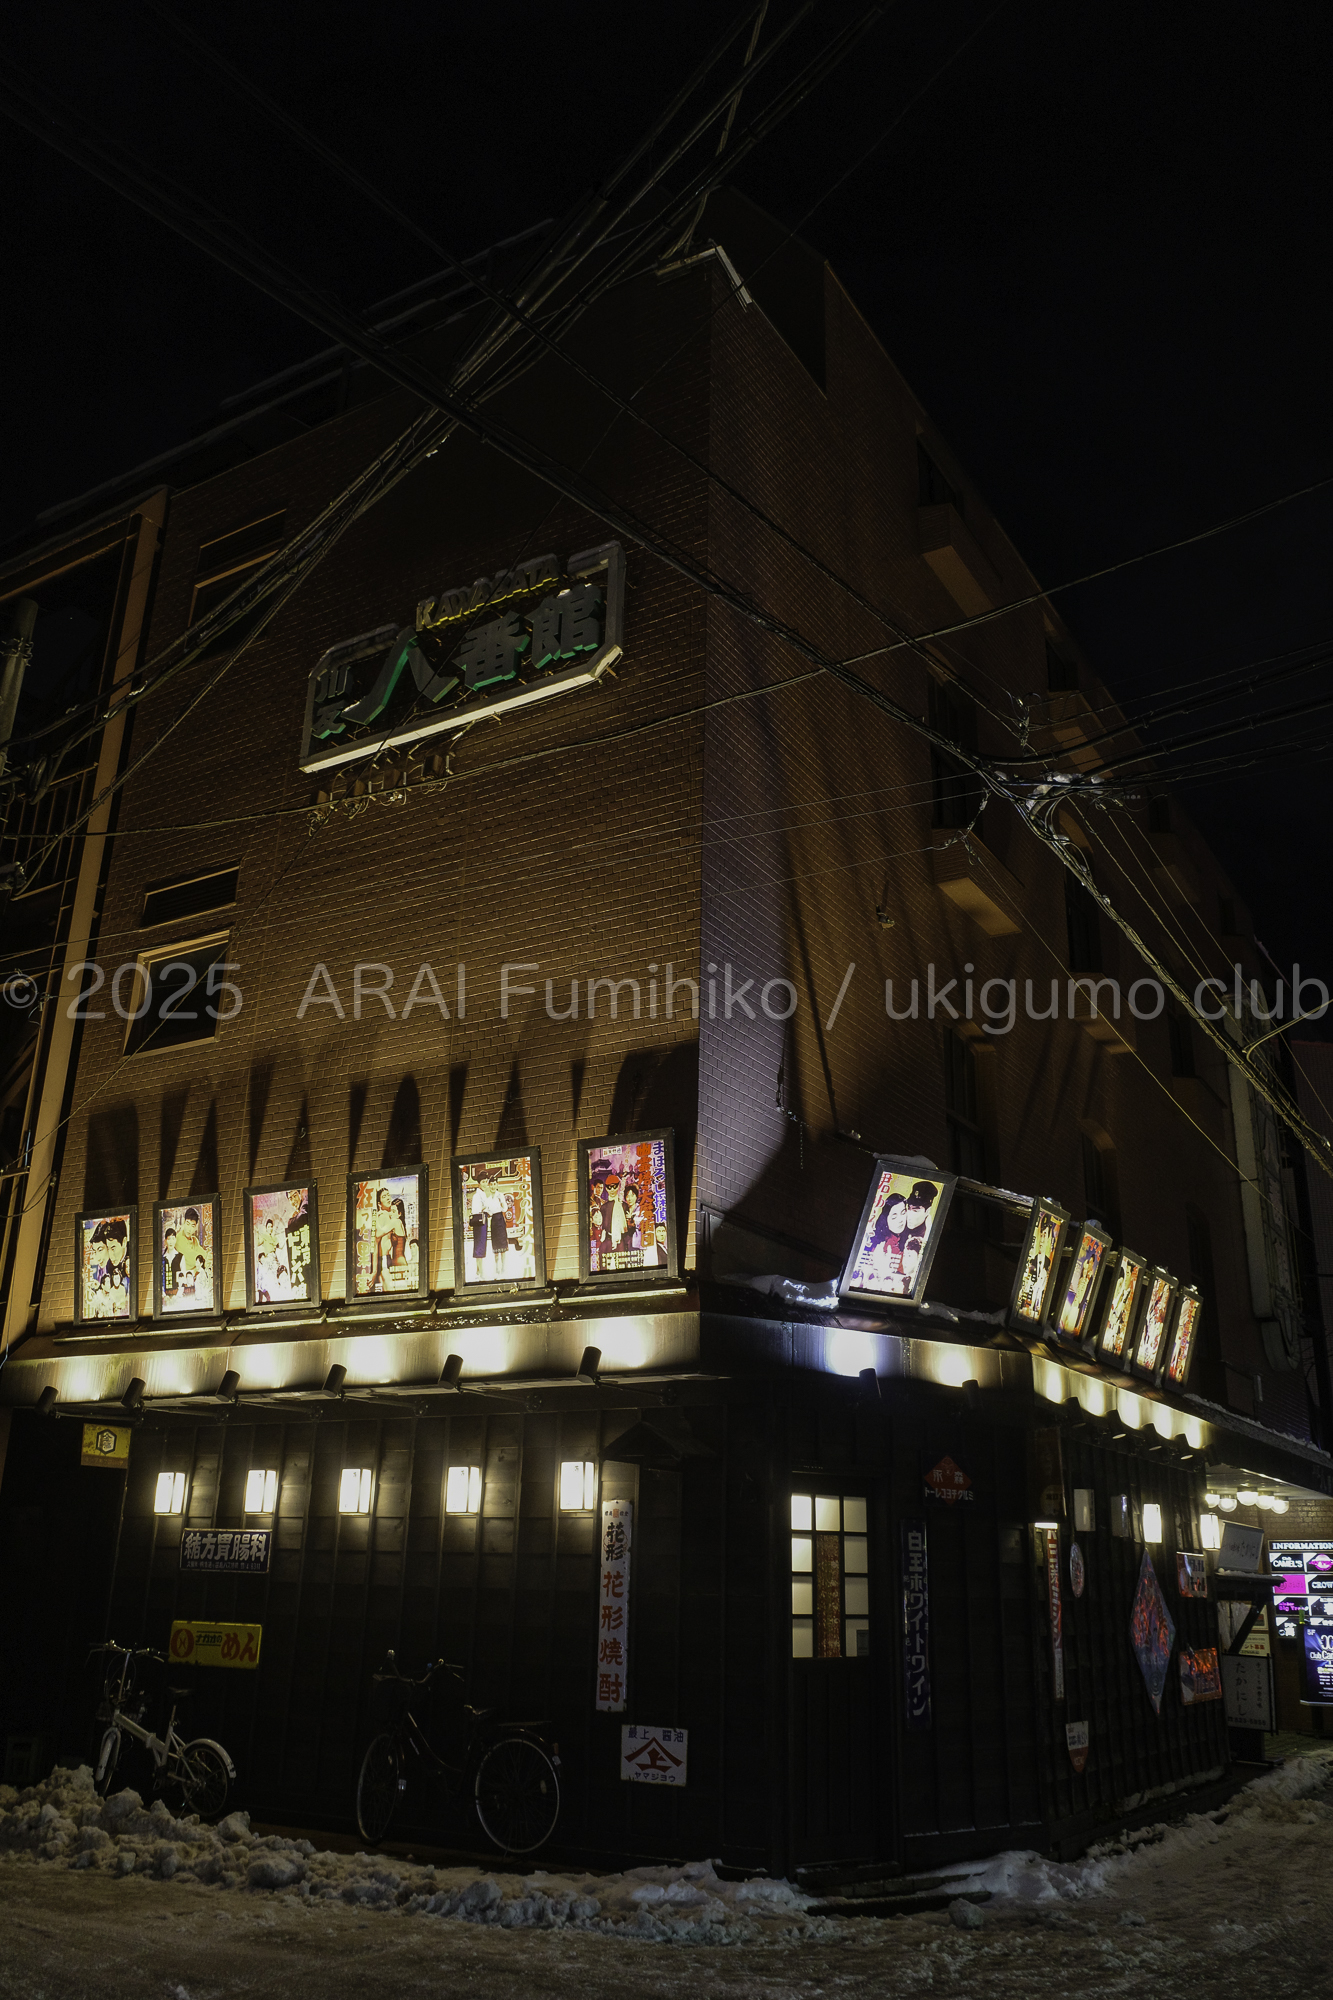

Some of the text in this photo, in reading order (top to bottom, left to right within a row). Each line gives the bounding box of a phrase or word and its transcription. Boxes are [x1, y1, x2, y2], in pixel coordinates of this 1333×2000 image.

[341, 584, 603, 726] 八番館
[184, 1532, 267, 1562] 緒方胃腸科
[605, 1521, 625, 1562] 花形
[1272, 1542, 1333, 1550] INFORMATION
[1236, 1662, 1248, 1715] たかにし
